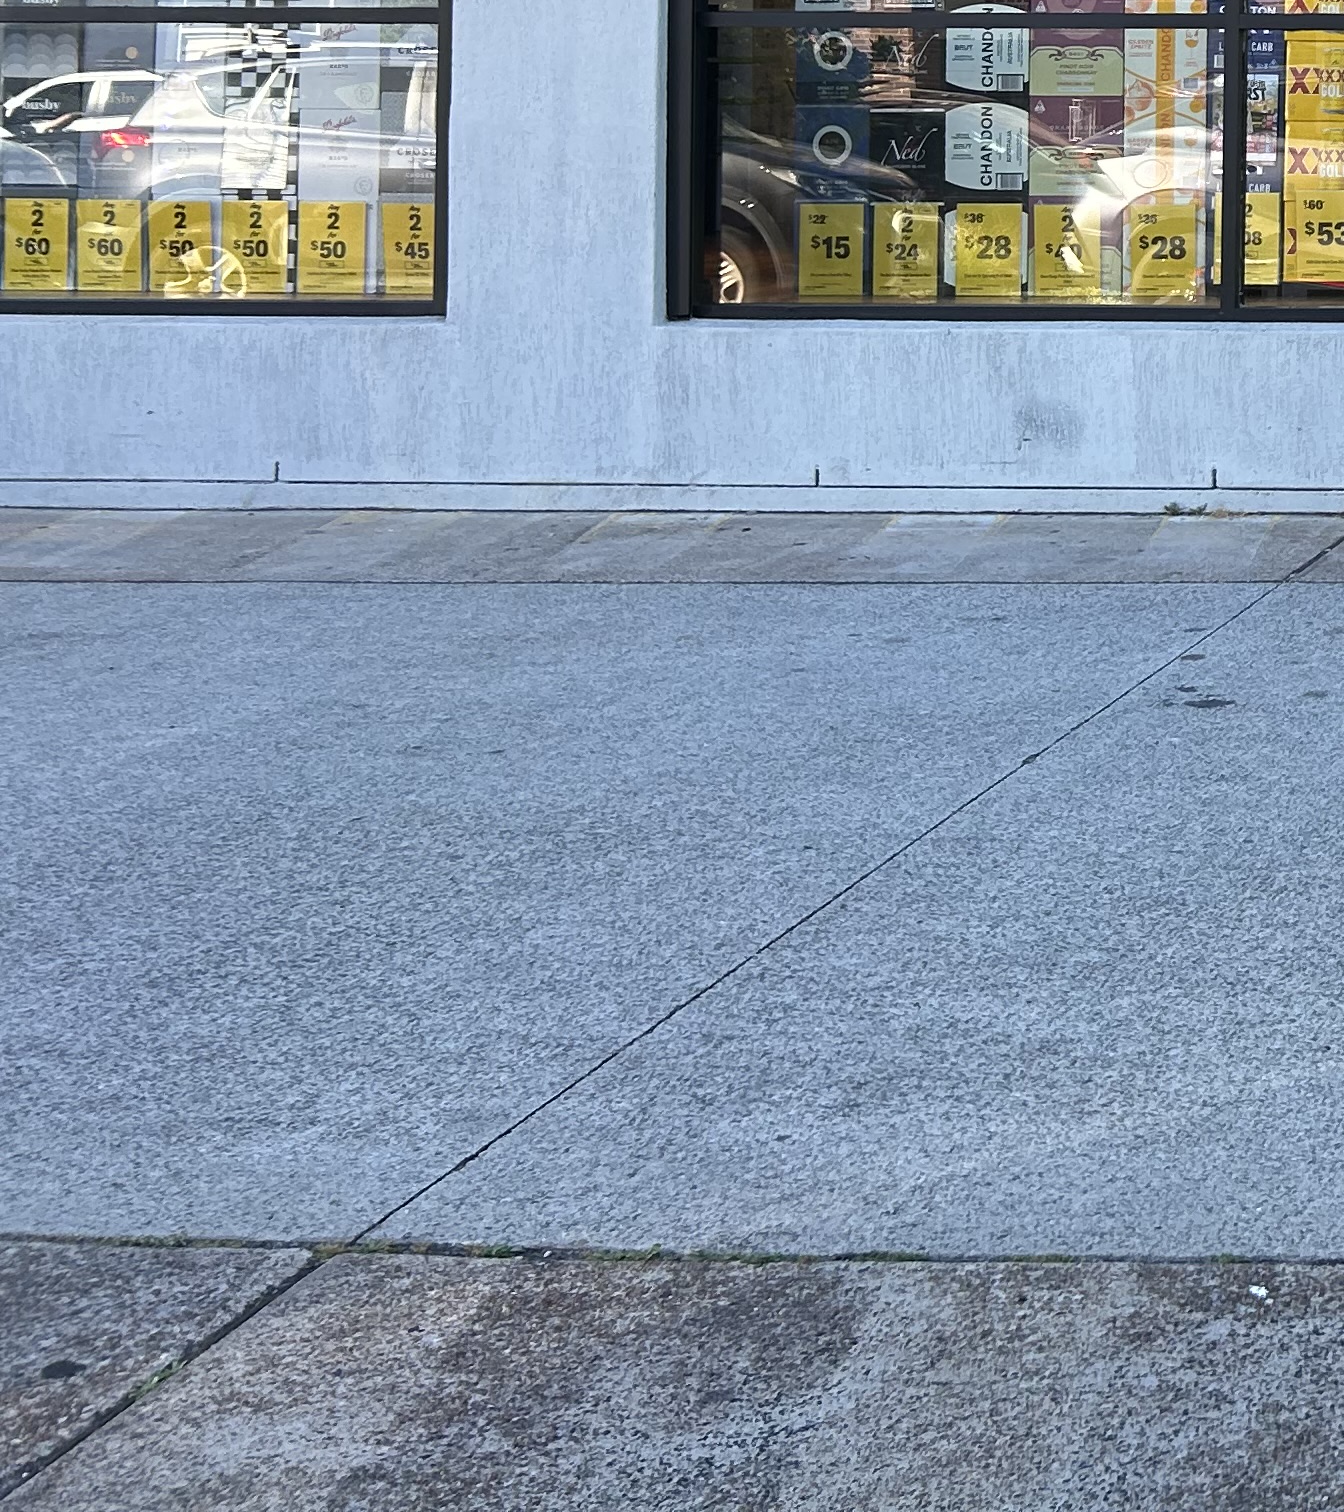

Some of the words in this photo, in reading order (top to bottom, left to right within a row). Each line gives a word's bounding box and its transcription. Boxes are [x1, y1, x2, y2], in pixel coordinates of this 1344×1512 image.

[1252, 42, 1273, 52] CARB
[981, 28, 994, 88] CHAND
[881, 128, 938, 165] Ned
[980, 107, 993, 186] CHANDON
[1249, 183, 1270, 193] CARB
[31, 209, 44, 227] 2
[103, 210, 116, 226] 2
[174, 211, 187, 229] 2
[249, 211, 262, 229] 2
[327, 212, 340, 230] 2
[409, 214, 422, 231] 2
[902, 217, 913, 233] 2
[1062, 215, 1074, 232] 2
[15, 237, 50, 255] $60
[88, 238, 123, 256] $60
[160, 239, 194, 258] $50
[233, 240, 268, 257] $50
[311, 240, 346, 259] $50
[395, 242, 430, 259] $45
[811, 235, 850, 259] $15
[886, 243, 919, 260] $24
[965, 235, 1011, 259] $28
[1139, 235, 1186, 260] $28
